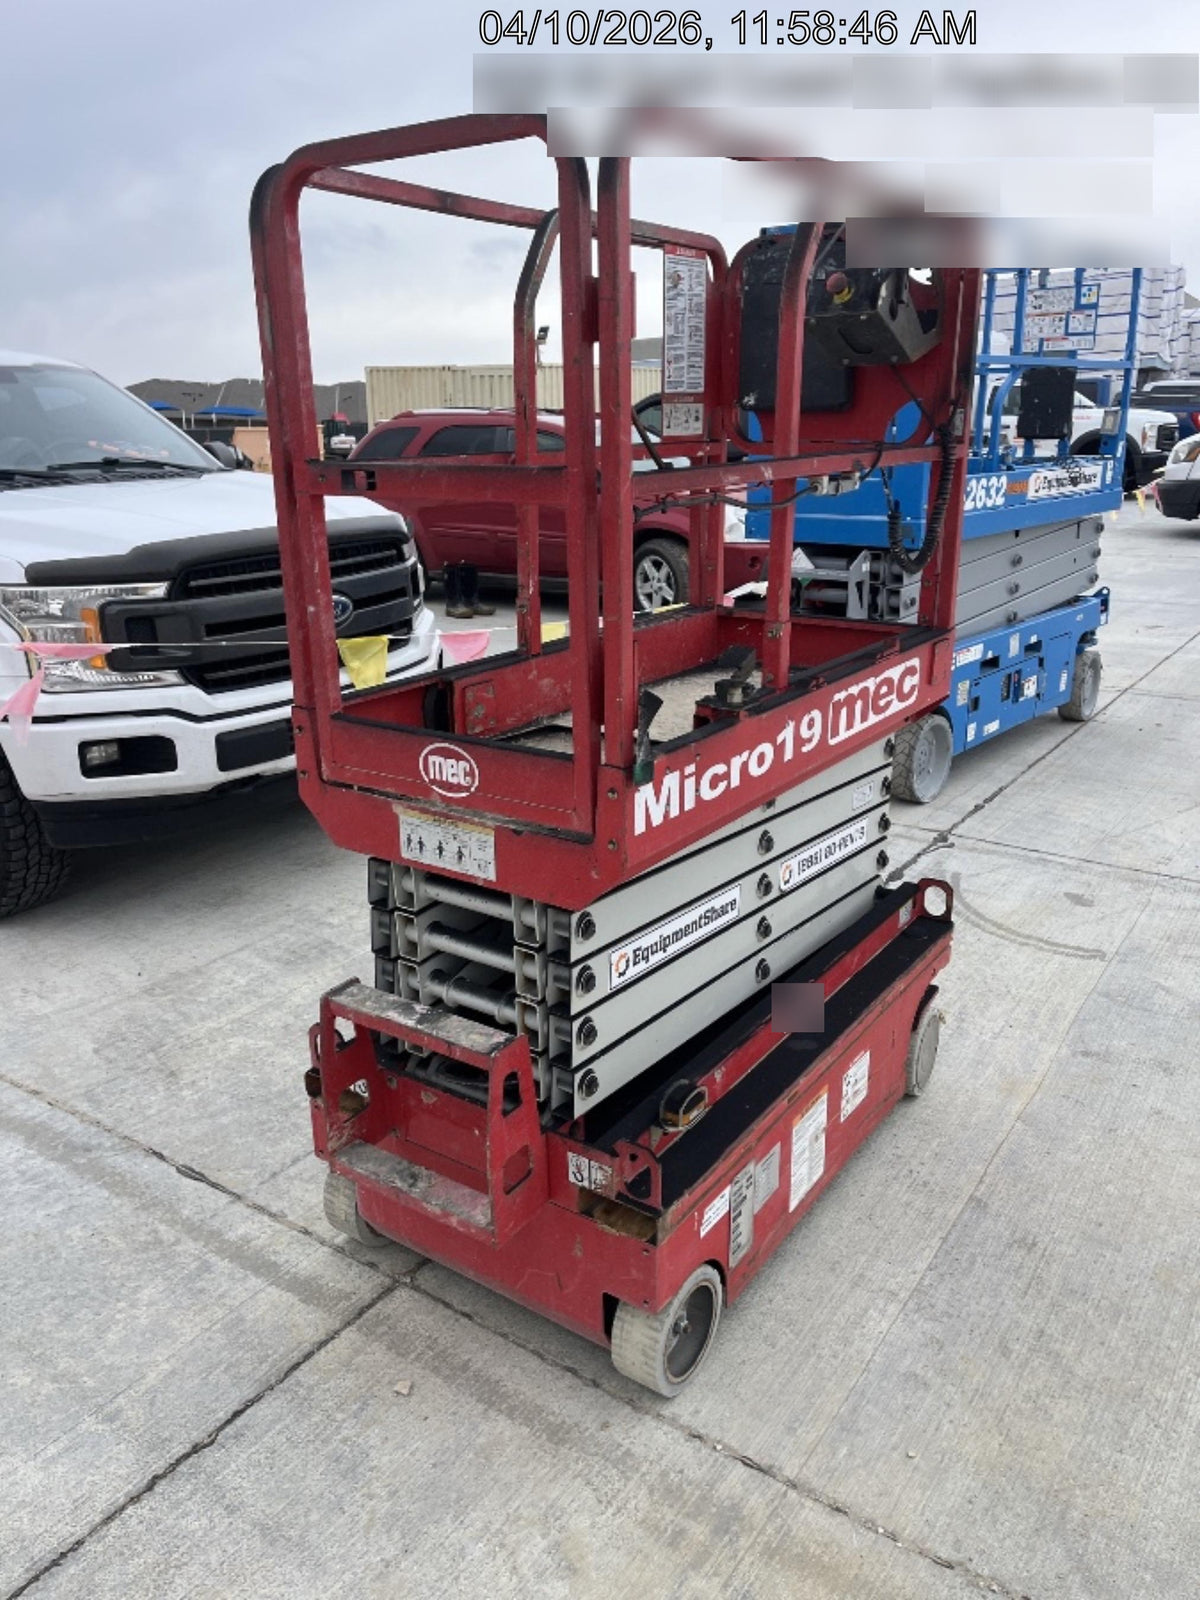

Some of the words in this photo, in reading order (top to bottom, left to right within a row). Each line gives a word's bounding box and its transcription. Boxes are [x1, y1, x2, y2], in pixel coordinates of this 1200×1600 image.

[829, 660, 919, 743] mec
[427, 755, 472, 787] mec
[632, 897, 737, 967] EquipmentShare
